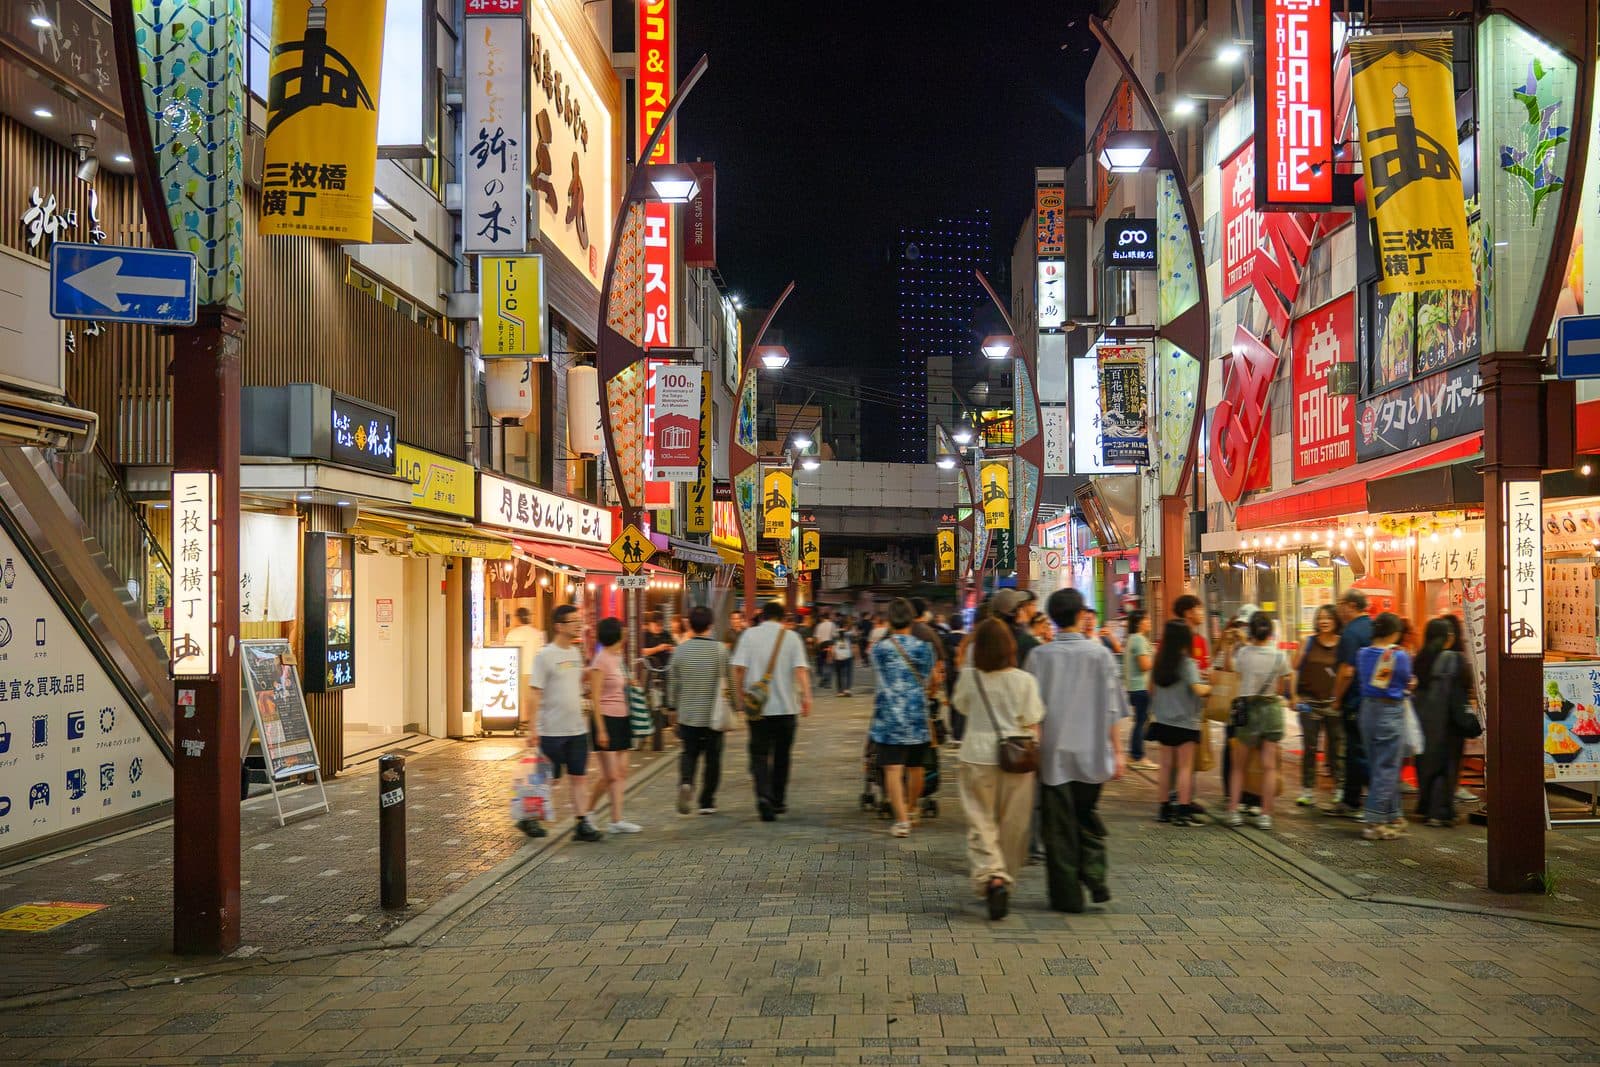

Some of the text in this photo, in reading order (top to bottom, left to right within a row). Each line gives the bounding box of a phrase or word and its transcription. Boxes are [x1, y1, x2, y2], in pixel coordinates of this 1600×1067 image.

[1276, 14, 1287, 191] TAITO STATION
[1288, 14, 1321, 191] GAME
[264, 162, 347, 190] 三枚橋
[263, 190, 317, 216] 横丁
[695, 223, 703, 245] STORE
[1382, 227, 1454, 251] 三枚橋
[1384, 252, 1433, 276] 横丁
[662, 374, 694, 388] 100th
[1299, 384, 1349, 445] GAME
[1045, 418, 1056, 469] ふくわらい
[1300, 439, 1350, 467] TAITO STATION
[500, 486, 602, 541] 月島もんじゃ 三九
[694, 505, 705, 526] 本店
[180, 485, 204, 620] 三枚橋横丁
[1514, 490, 1537, 606] 三枚橋横丁
[485, 665, 516, 711] 三九
